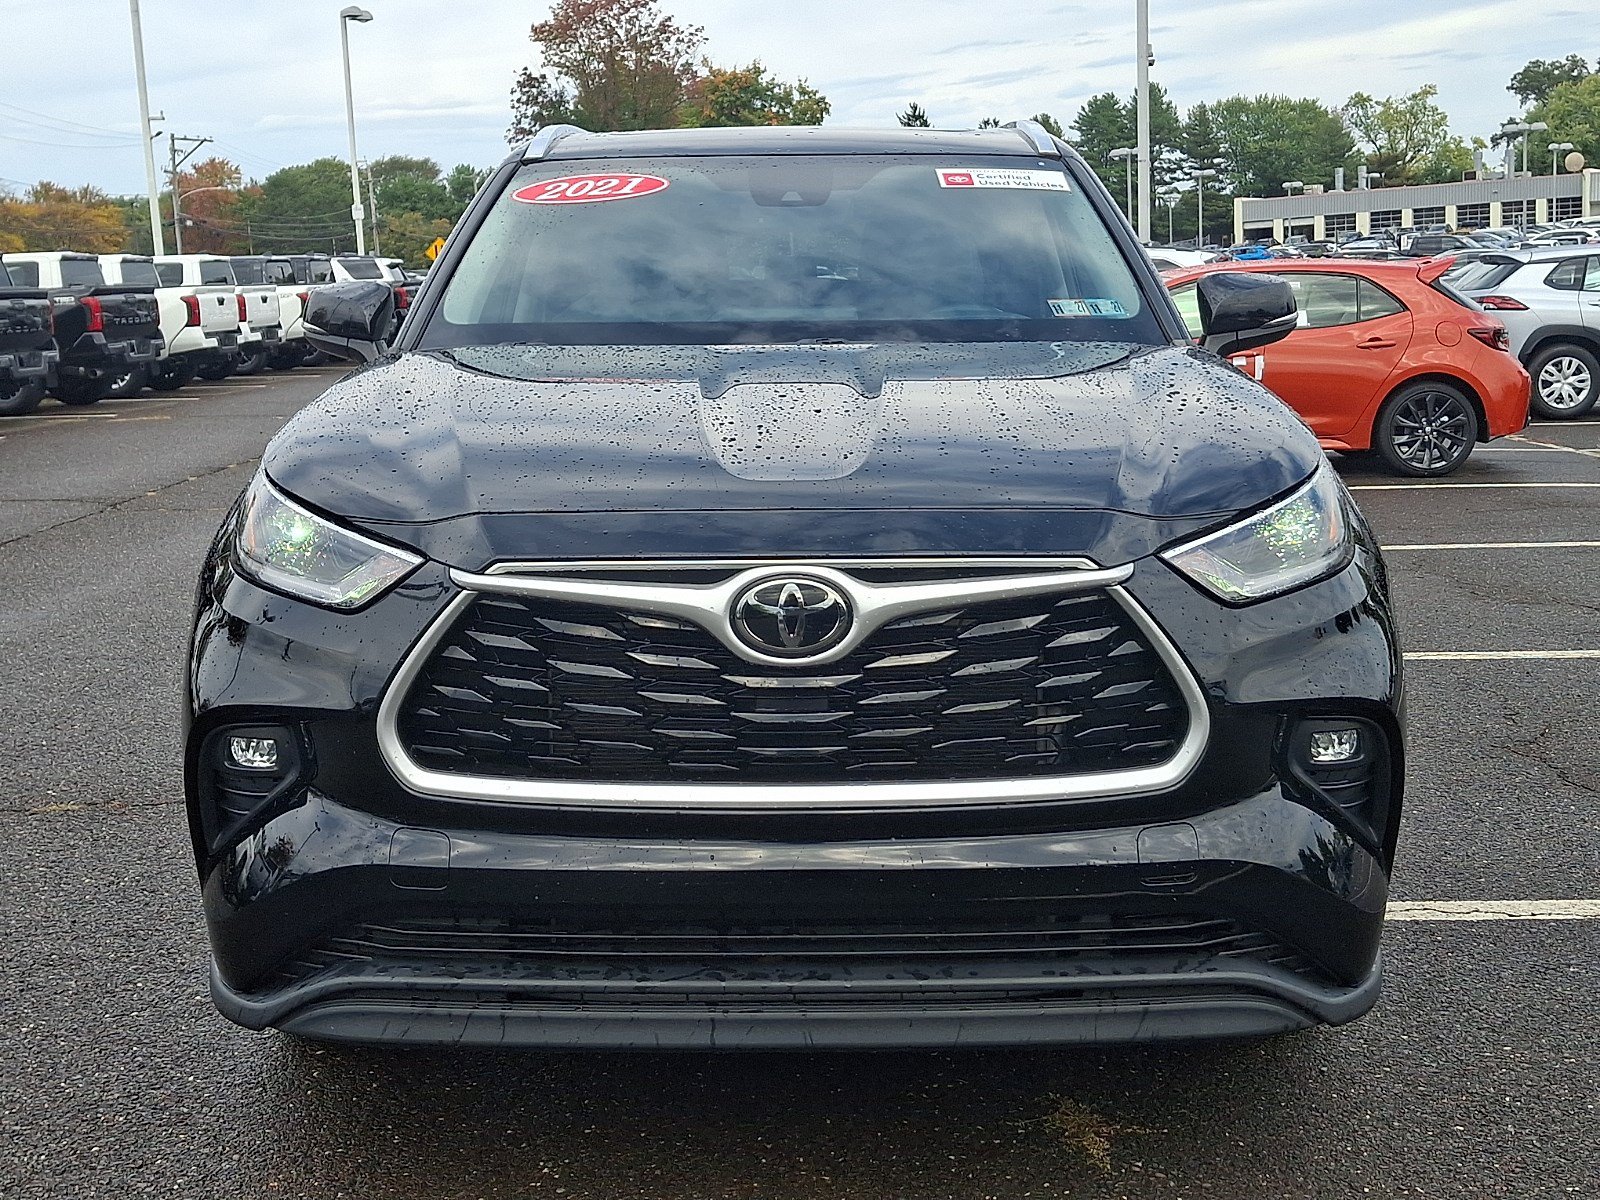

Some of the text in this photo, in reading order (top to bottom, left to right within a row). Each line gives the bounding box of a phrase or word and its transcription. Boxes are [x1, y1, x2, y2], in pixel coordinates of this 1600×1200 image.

[976, 173, 1031, 181] Certified
[534, 177, 644, 200] 2021
[1013, 180, 1064, 188] Vehicles
[113, 315, 152, 325] TACOMA
